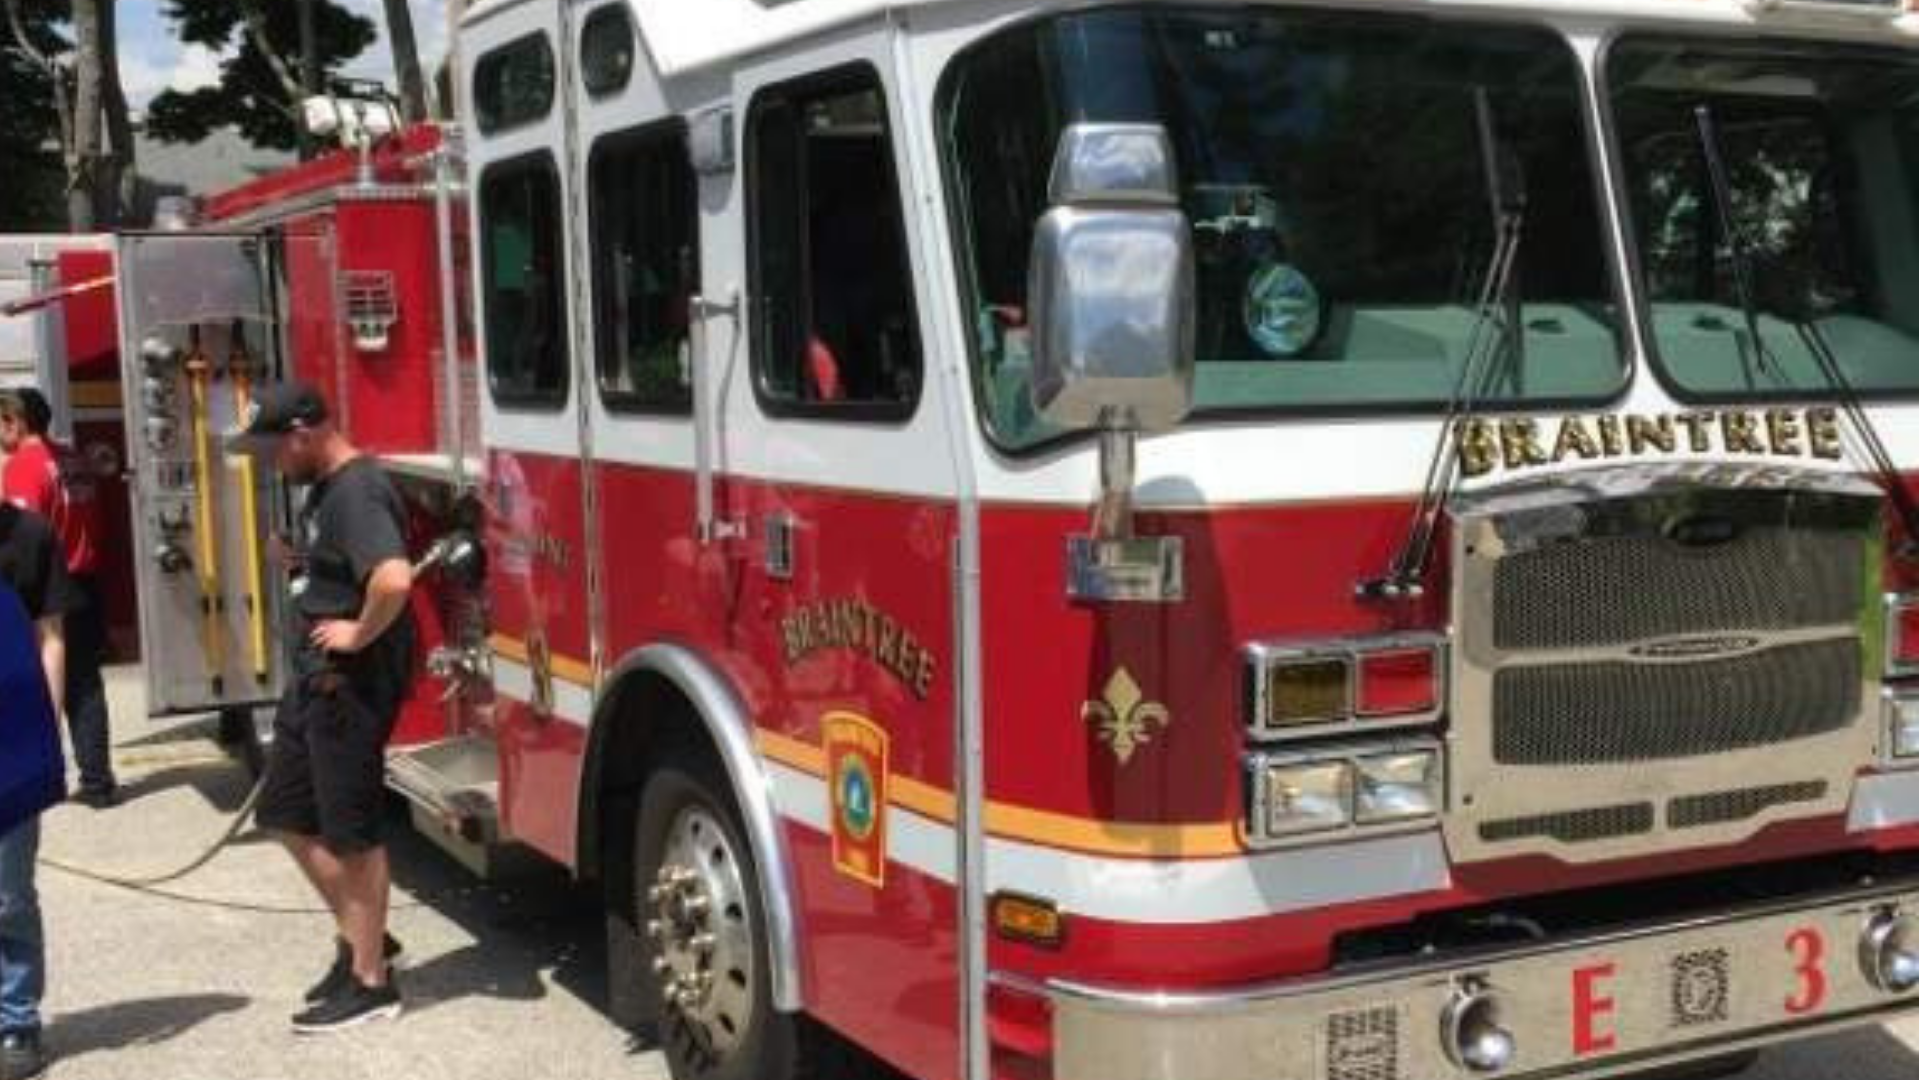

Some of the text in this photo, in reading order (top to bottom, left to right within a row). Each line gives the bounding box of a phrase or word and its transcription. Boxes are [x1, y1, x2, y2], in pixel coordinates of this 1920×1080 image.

[1456, 408, 1842, 477] BRAINTREE
[782, 600, 934, 700] BRAINTREE
[1570, 927, 1826, 1056] E 3
